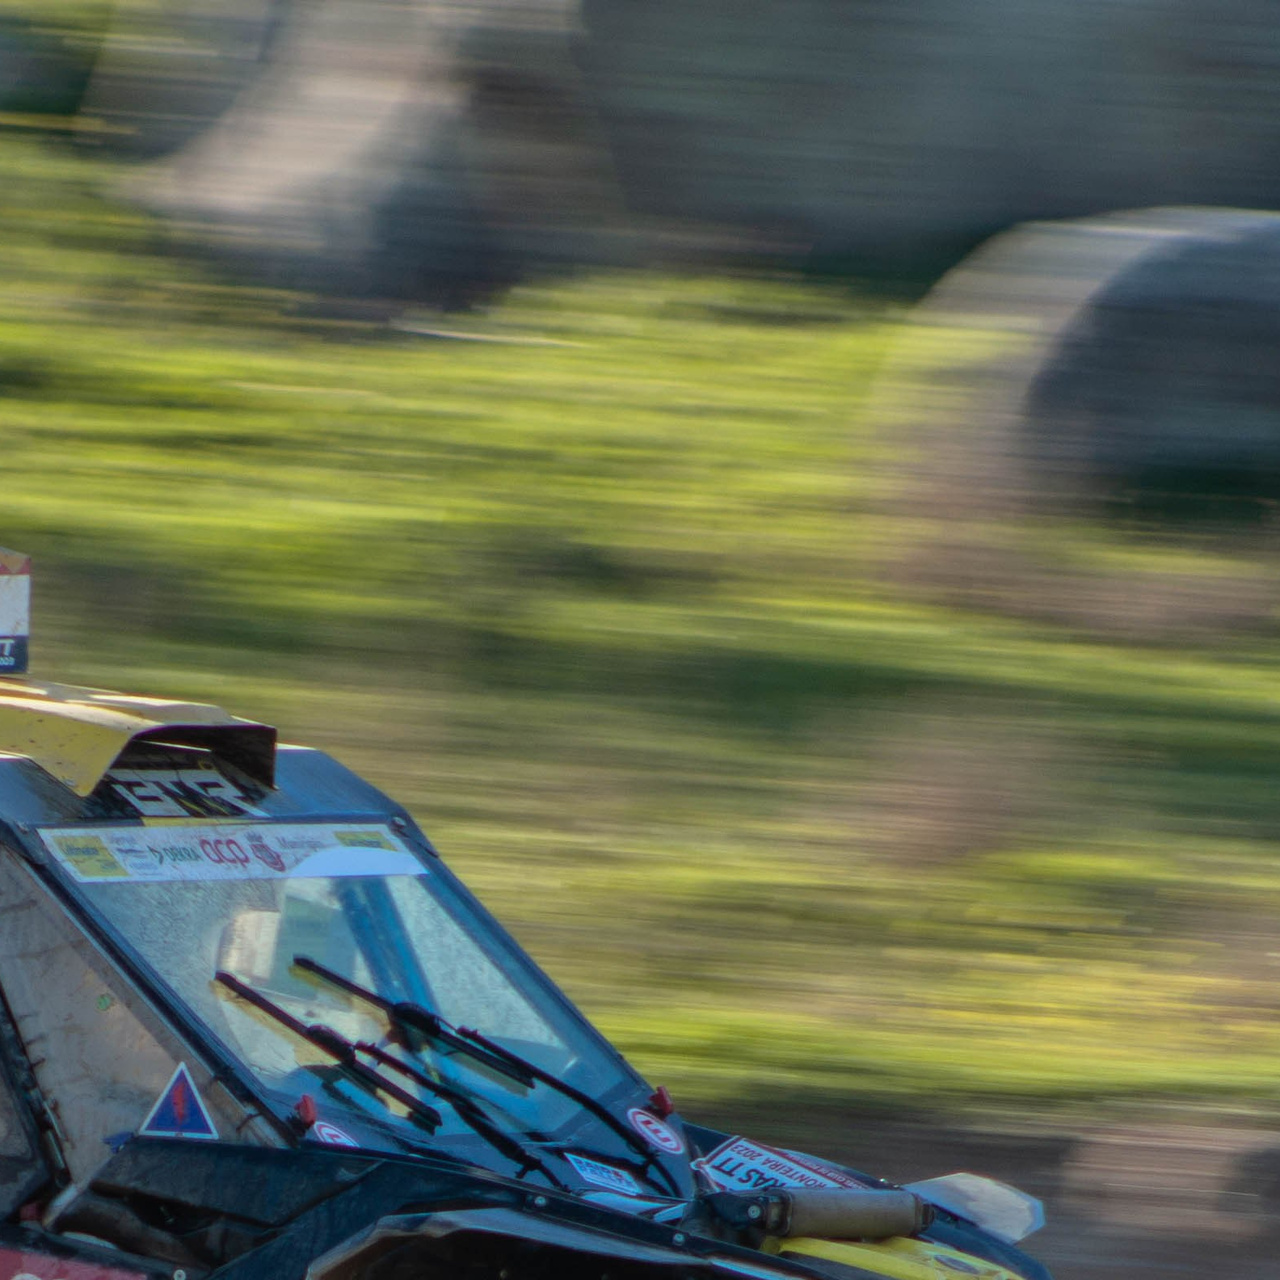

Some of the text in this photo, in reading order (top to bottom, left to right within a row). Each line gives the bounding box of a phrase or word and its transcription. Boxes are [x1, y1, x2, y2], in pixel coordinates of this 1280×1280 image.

[200, 838, 251, 869] acp
[730, 1144, 763, 1161] 2023
[711, 1157, 744, 1177] TT
